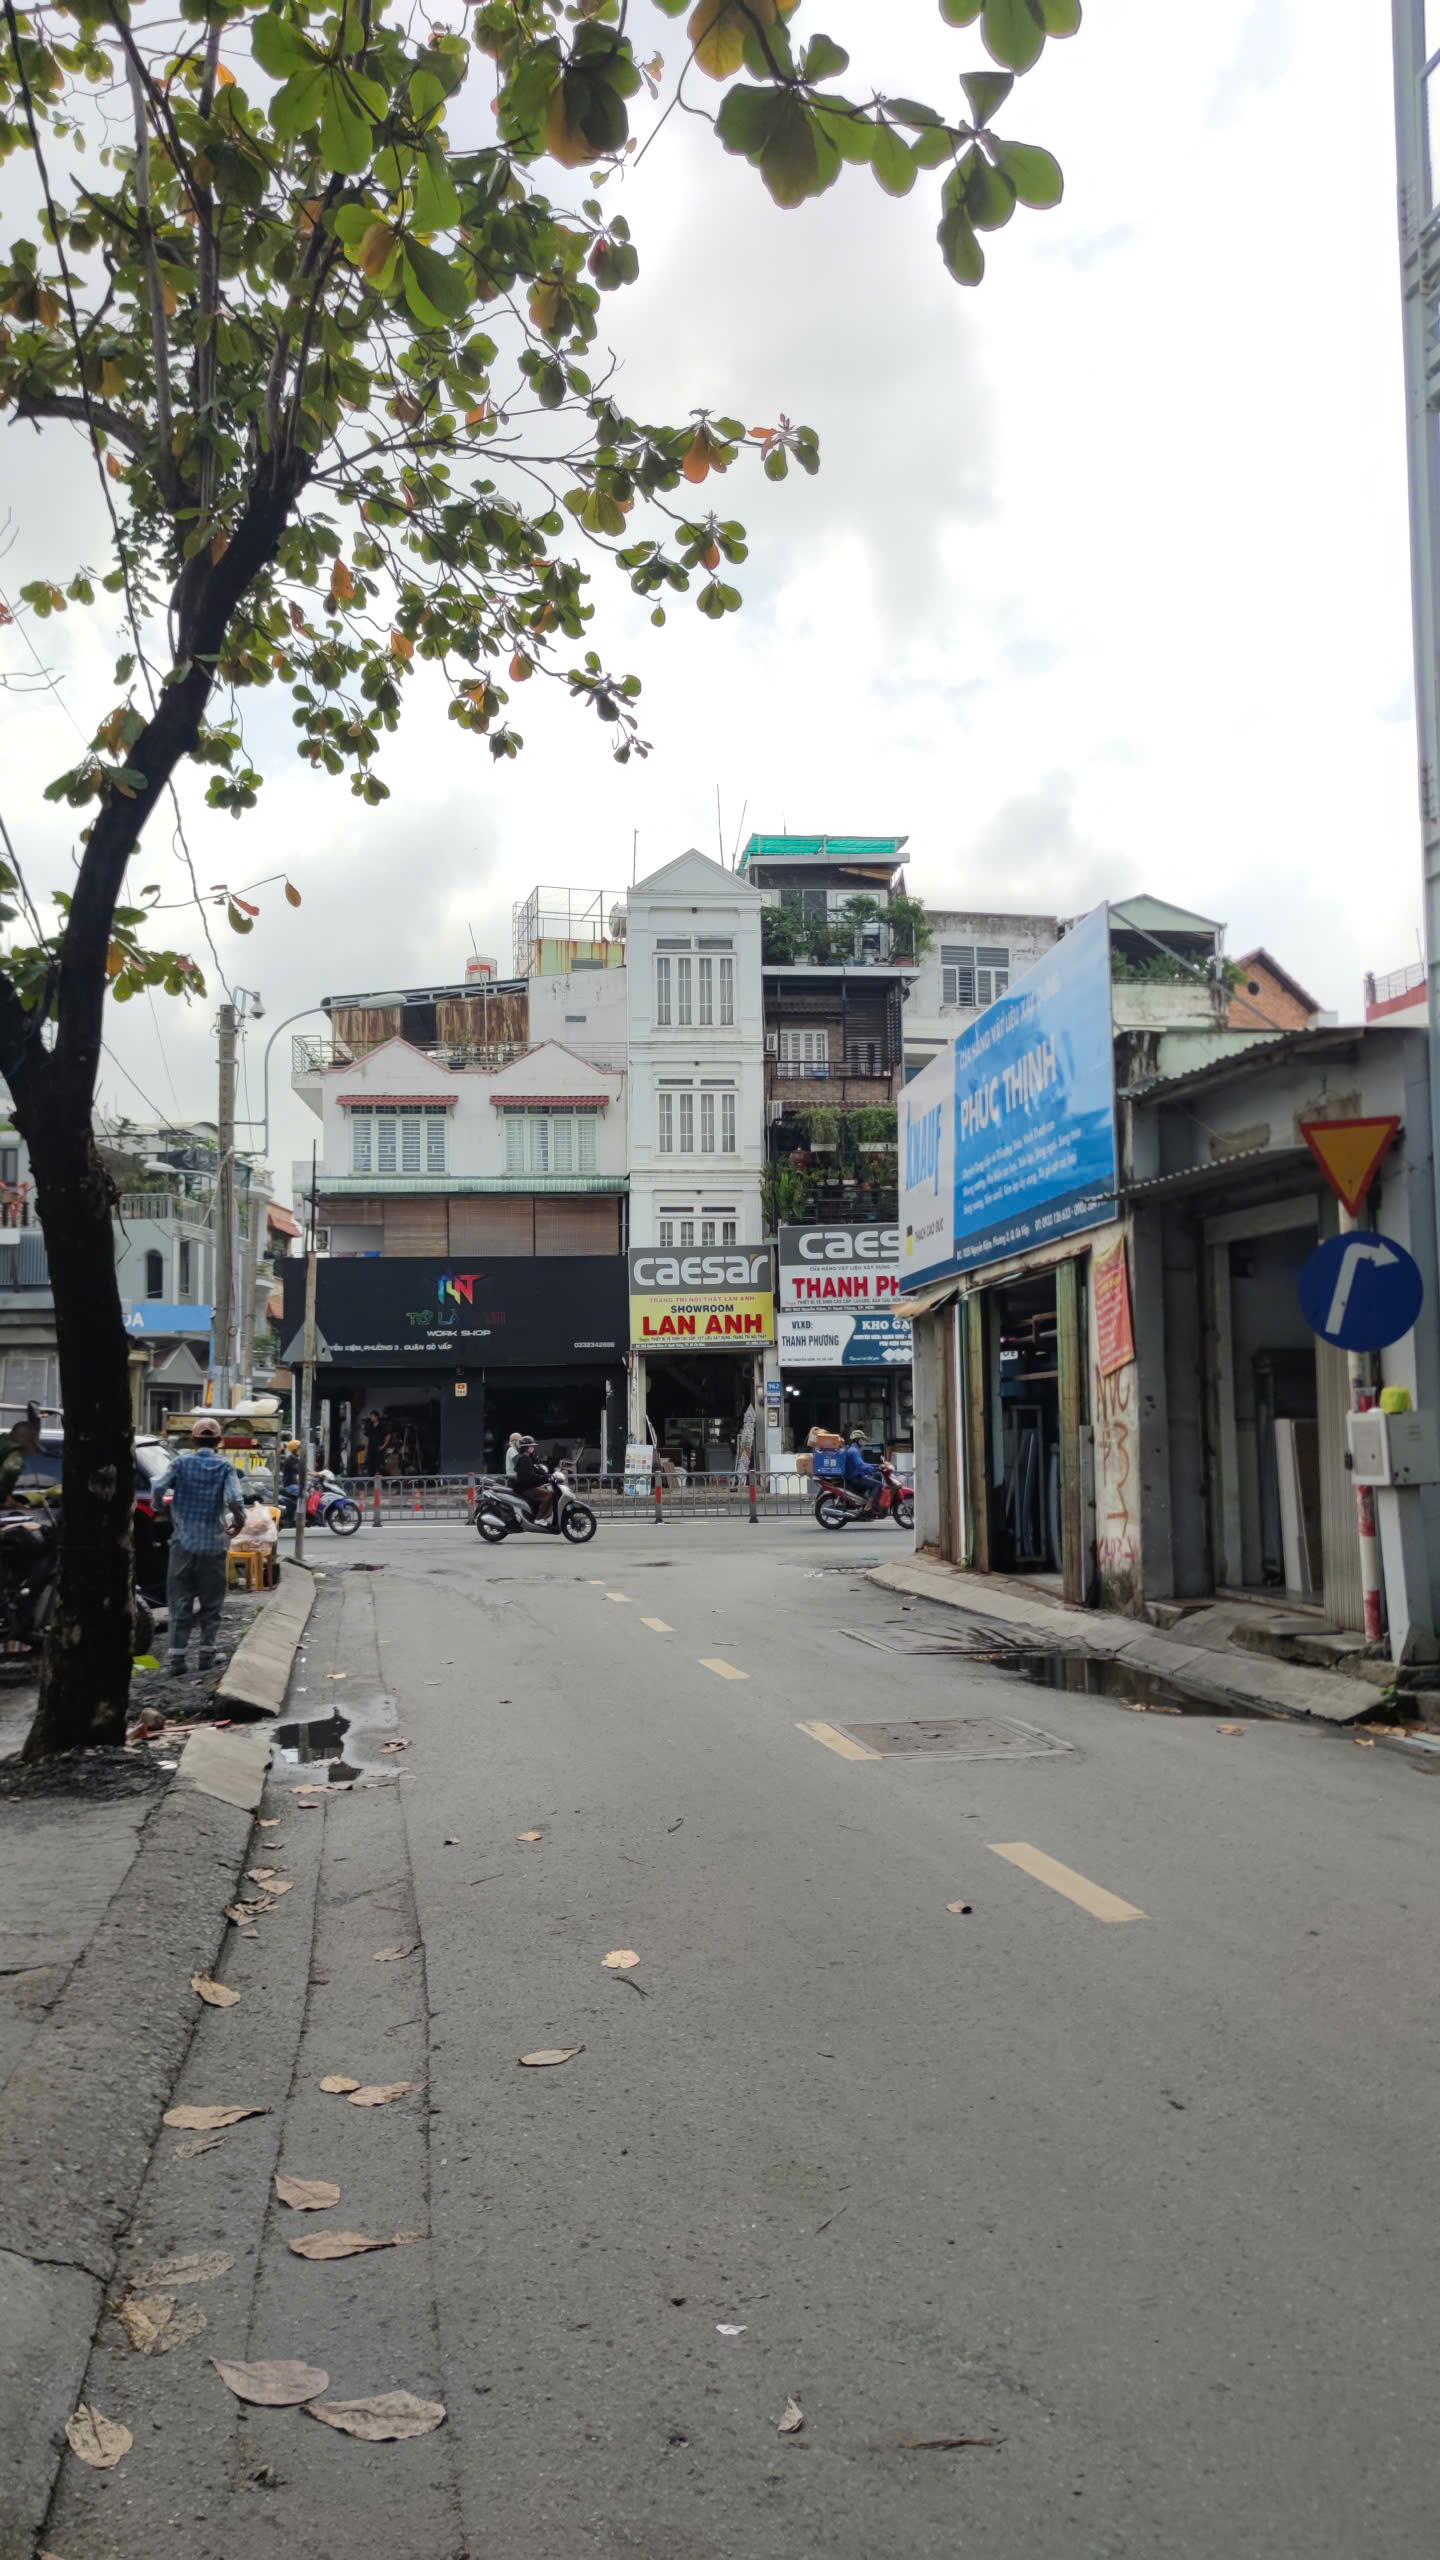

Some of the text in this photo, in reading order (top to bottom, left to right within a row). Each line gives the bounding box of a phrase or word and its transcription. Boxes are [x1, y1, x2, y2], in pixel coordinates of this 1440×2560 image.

[961, 1031, 1058, 1143] PHÚC THỊNH
[799, 1230, 899, 1260] caes
[792, 1276, 868, 1298] THANH
[671, 1304, 734, 1314] SHOWROOM
[643, 1313, 762, 1336] LAN ANH
[792, 1321, 813, 1329] VLXD:
[862, 1321, 889, 1331] KHO
[782, 1335, 806, 1346] THANH
[426, 1343, 436, 1351] GÒ
